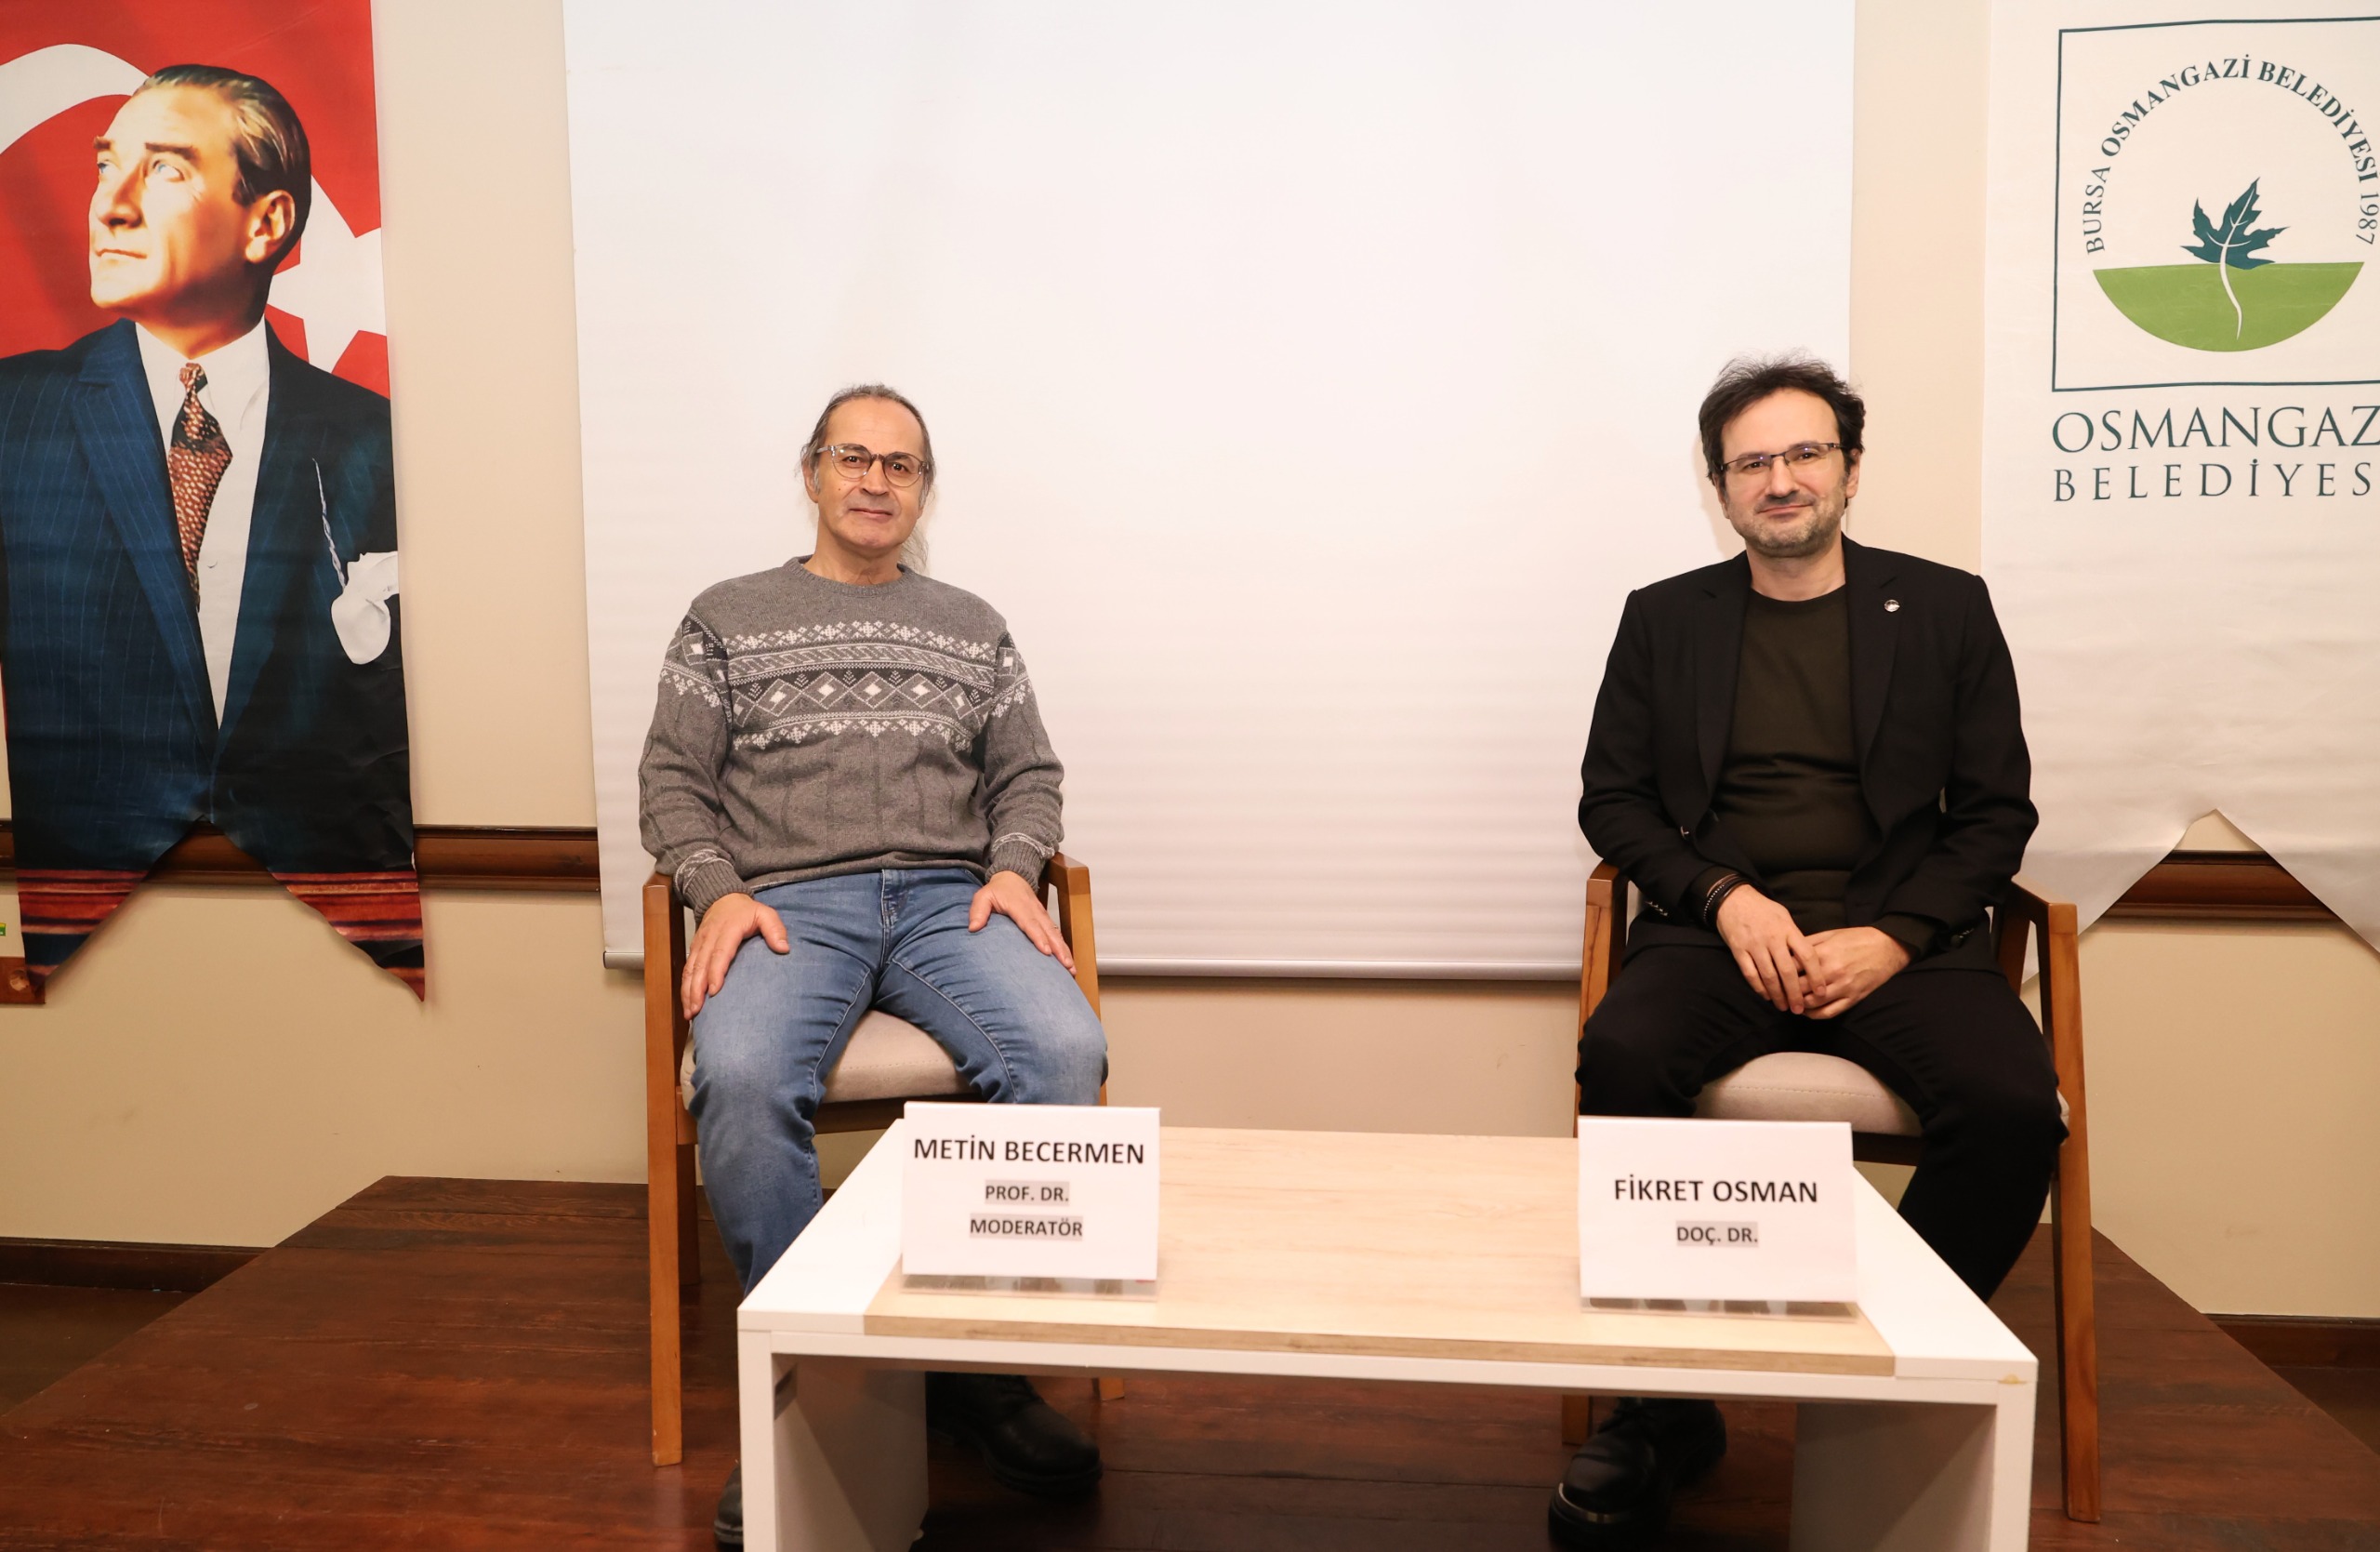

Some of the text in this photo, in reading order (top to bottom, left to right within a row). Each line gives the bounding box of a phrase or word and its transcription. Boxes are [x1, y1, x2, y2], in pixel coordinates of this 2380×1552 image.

[2082, 166, 2111, 255] BURSA
[2101, 53, 2251, 157] OSMANGAZİ
[2355, 192, 2380, 245] 1987
[2053, 458, 2371, 501] BELEDİYES
[914, 1134, 1144, 1164] METİN BECERMEN
[985, 1185, 1069, 1201] PROF. DR.
[1615, 1174, 1818, 1203] FİKRET OSMAN
[970, 1216, 1083, 1237] MODERATÖR
[1676, 1226, 1758, 1246] DOÇ. DR.
